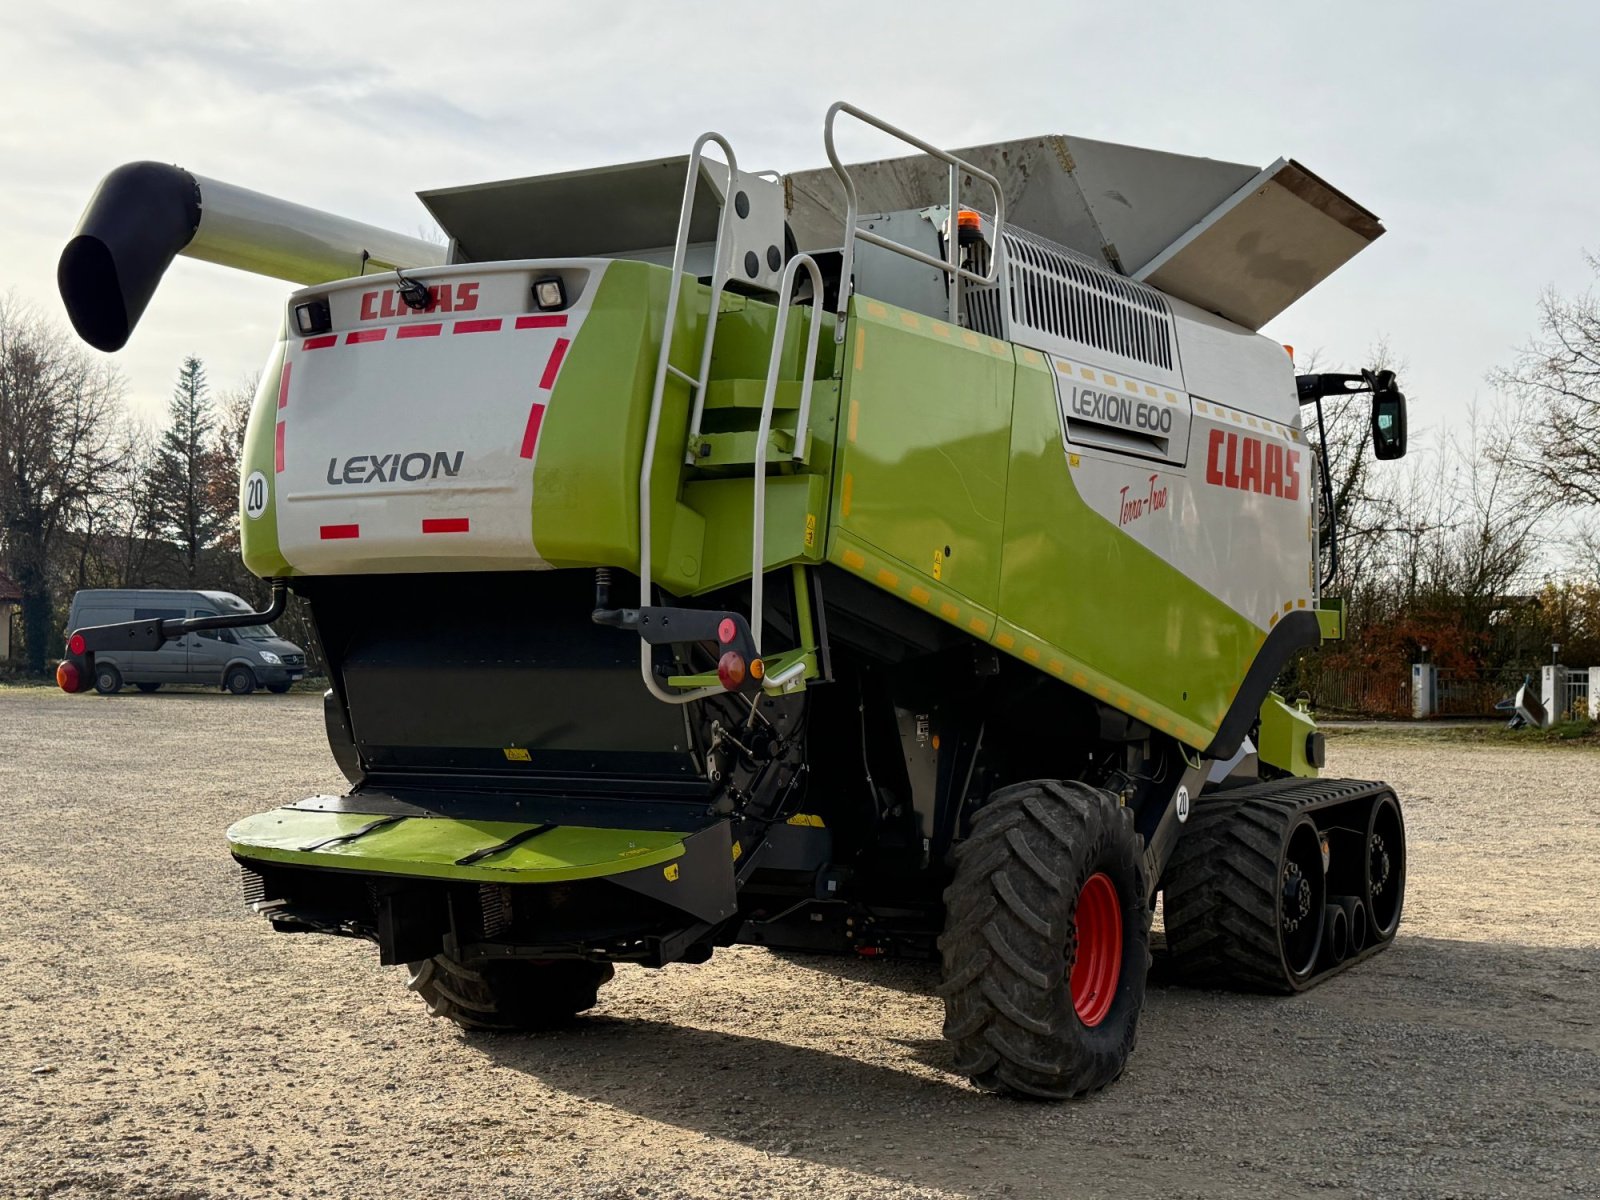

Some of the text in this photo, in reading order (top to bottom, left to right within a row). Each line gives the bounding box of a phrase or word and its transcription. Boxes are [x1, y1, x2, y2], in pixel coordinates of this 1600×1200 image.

[1072, 386, 1172, 433] LEXION 600
[327, 451, 465, 485] LEXION
[1206, 428, 1300, 501] CLAAS
[248, 478, 263, 511] 20
[1179, 791, 1187, 816] 20
